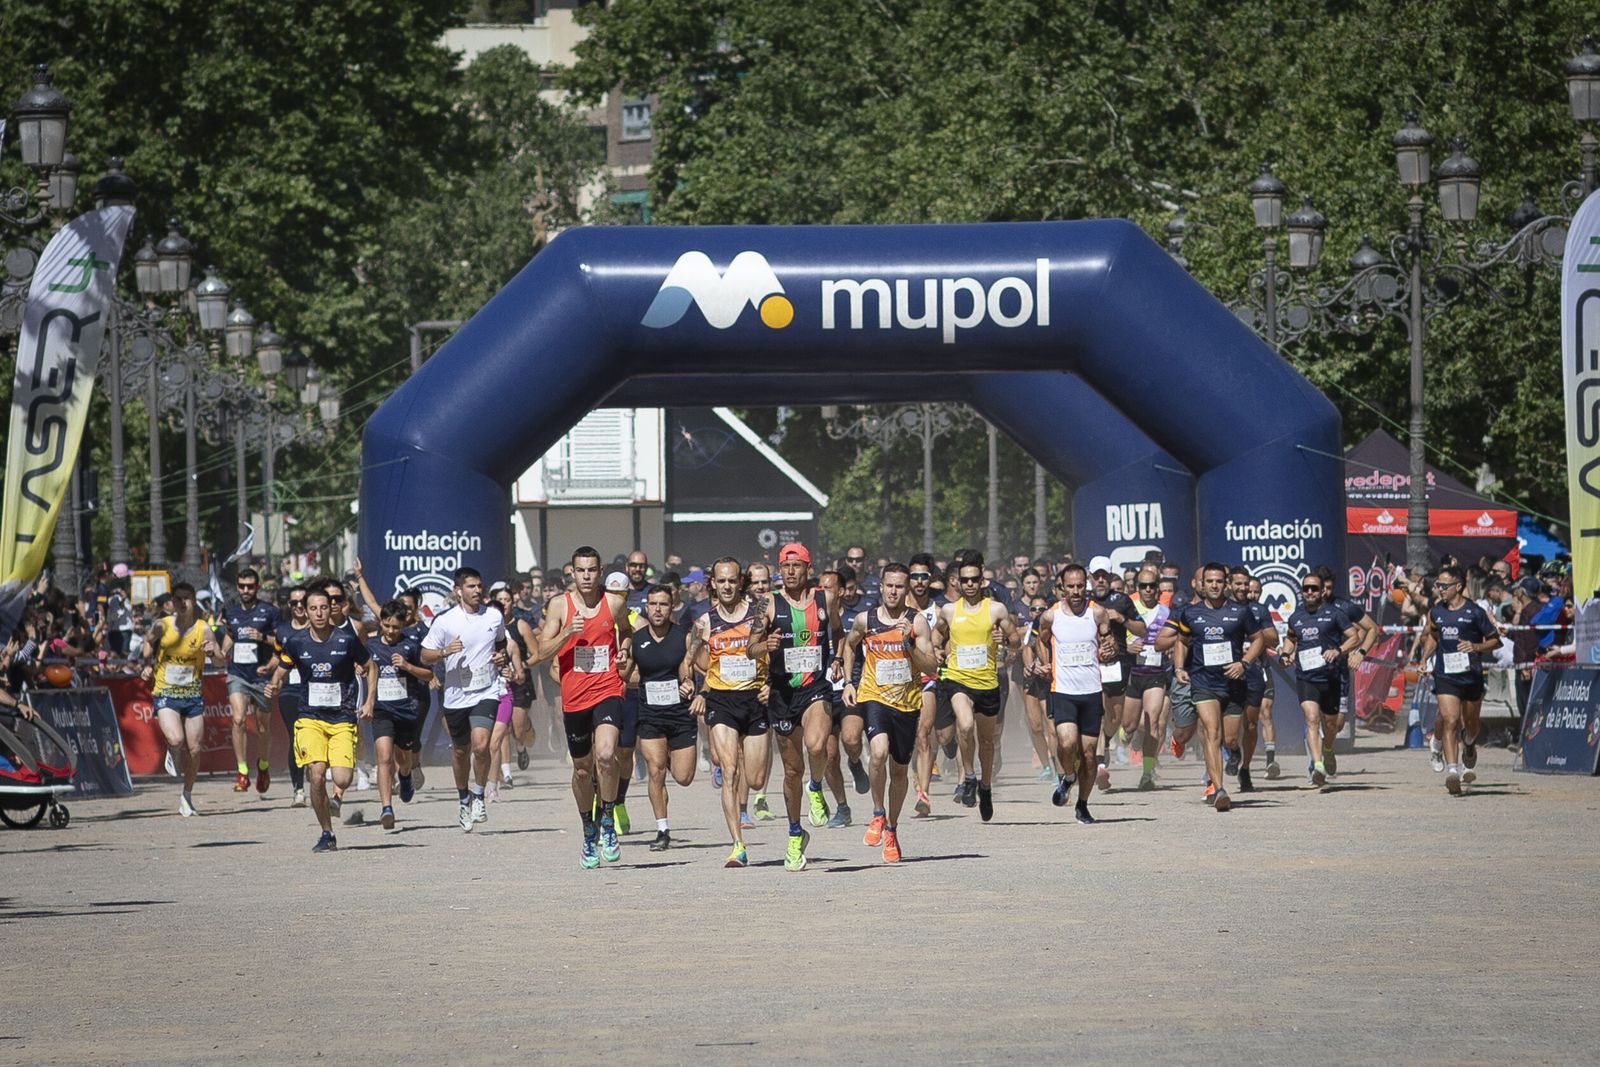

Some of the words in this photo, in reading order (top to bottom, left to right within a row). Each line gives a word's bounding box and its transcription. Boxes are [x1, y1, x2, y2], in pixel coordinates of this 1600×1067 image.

[821, 257, 1051, 344] mupol
[1106, 502, 1164, 541] RUTA
[1225, 518, 1323, 541] fundación
[384, 529, 481, 551] fundación
[1241, 539, 1304, 564] mupol
[400, 551, 462, 575] mupol
[1553, 680, 1592, 702] Mutualidad
[1545, 707, 1555, 728] de
[1554, 708, 1562, 728] la
[1561, 707, 1588, 729] Policía
